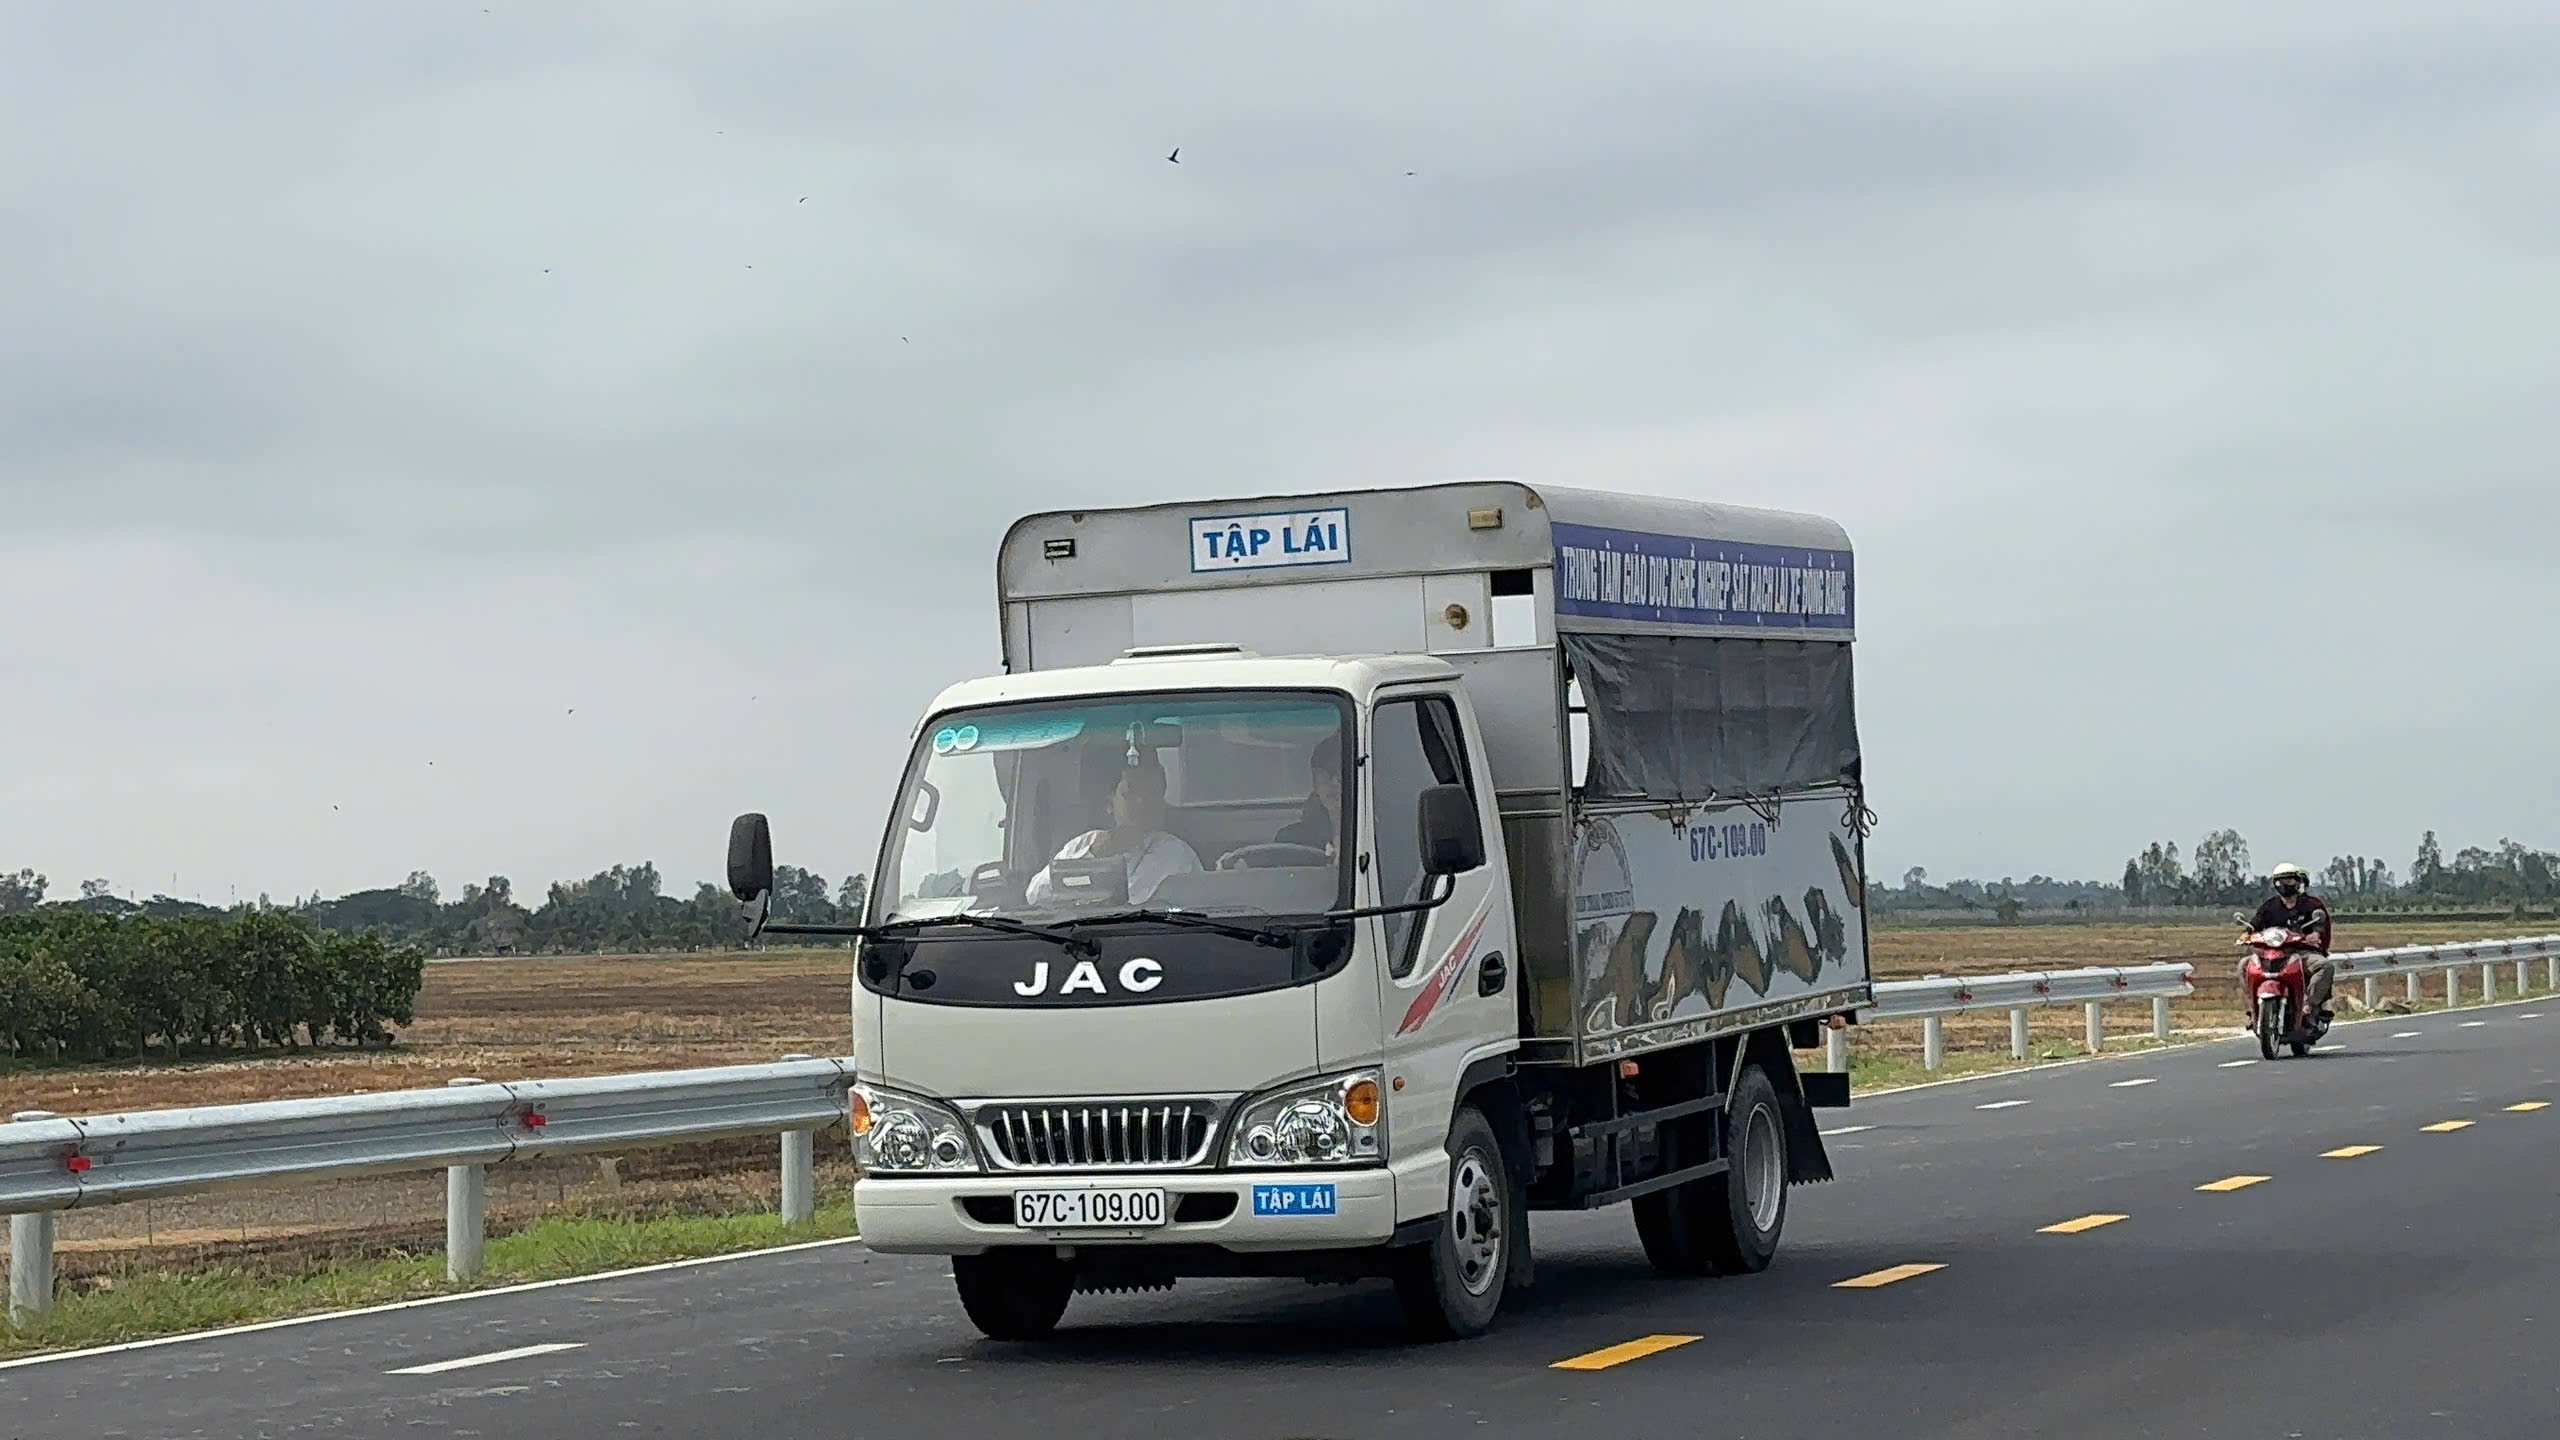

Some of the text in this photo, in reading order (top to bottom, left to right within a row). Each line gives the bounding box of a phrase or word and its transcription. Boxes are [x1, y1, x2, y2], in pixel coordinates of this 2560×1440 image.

[1202, 517, 1338, 563] TẬP LÁI
[1562, 546, 1598, 602] TRUNG
[1599, 540, 1621, 603] TÂM
[1623, 543, 1647, 606] GIÁO
[1649, 555, 1669, 618] DỤC
[1670, 543, 1696, 609] NGHỀ
[1697, 551, 1731, 622] NGHIỆP
[1732, 553, 1749, 612] SÁT
[1750, 564, 1774, 623] HẠCH
[1774, 556, 1788, 614] LÁI
[1789, 567, 1801, 614] XE
[1690, 823, 1766, 862] 67C-109.00
[1013, 957, 1163, 996] JAC
[1438, 955, 1457, 990] JAC
[1020, 1192, 1161, 1224] 67C-109.00
[1256, 1186, 1331, 1213] TẬP LÁI
